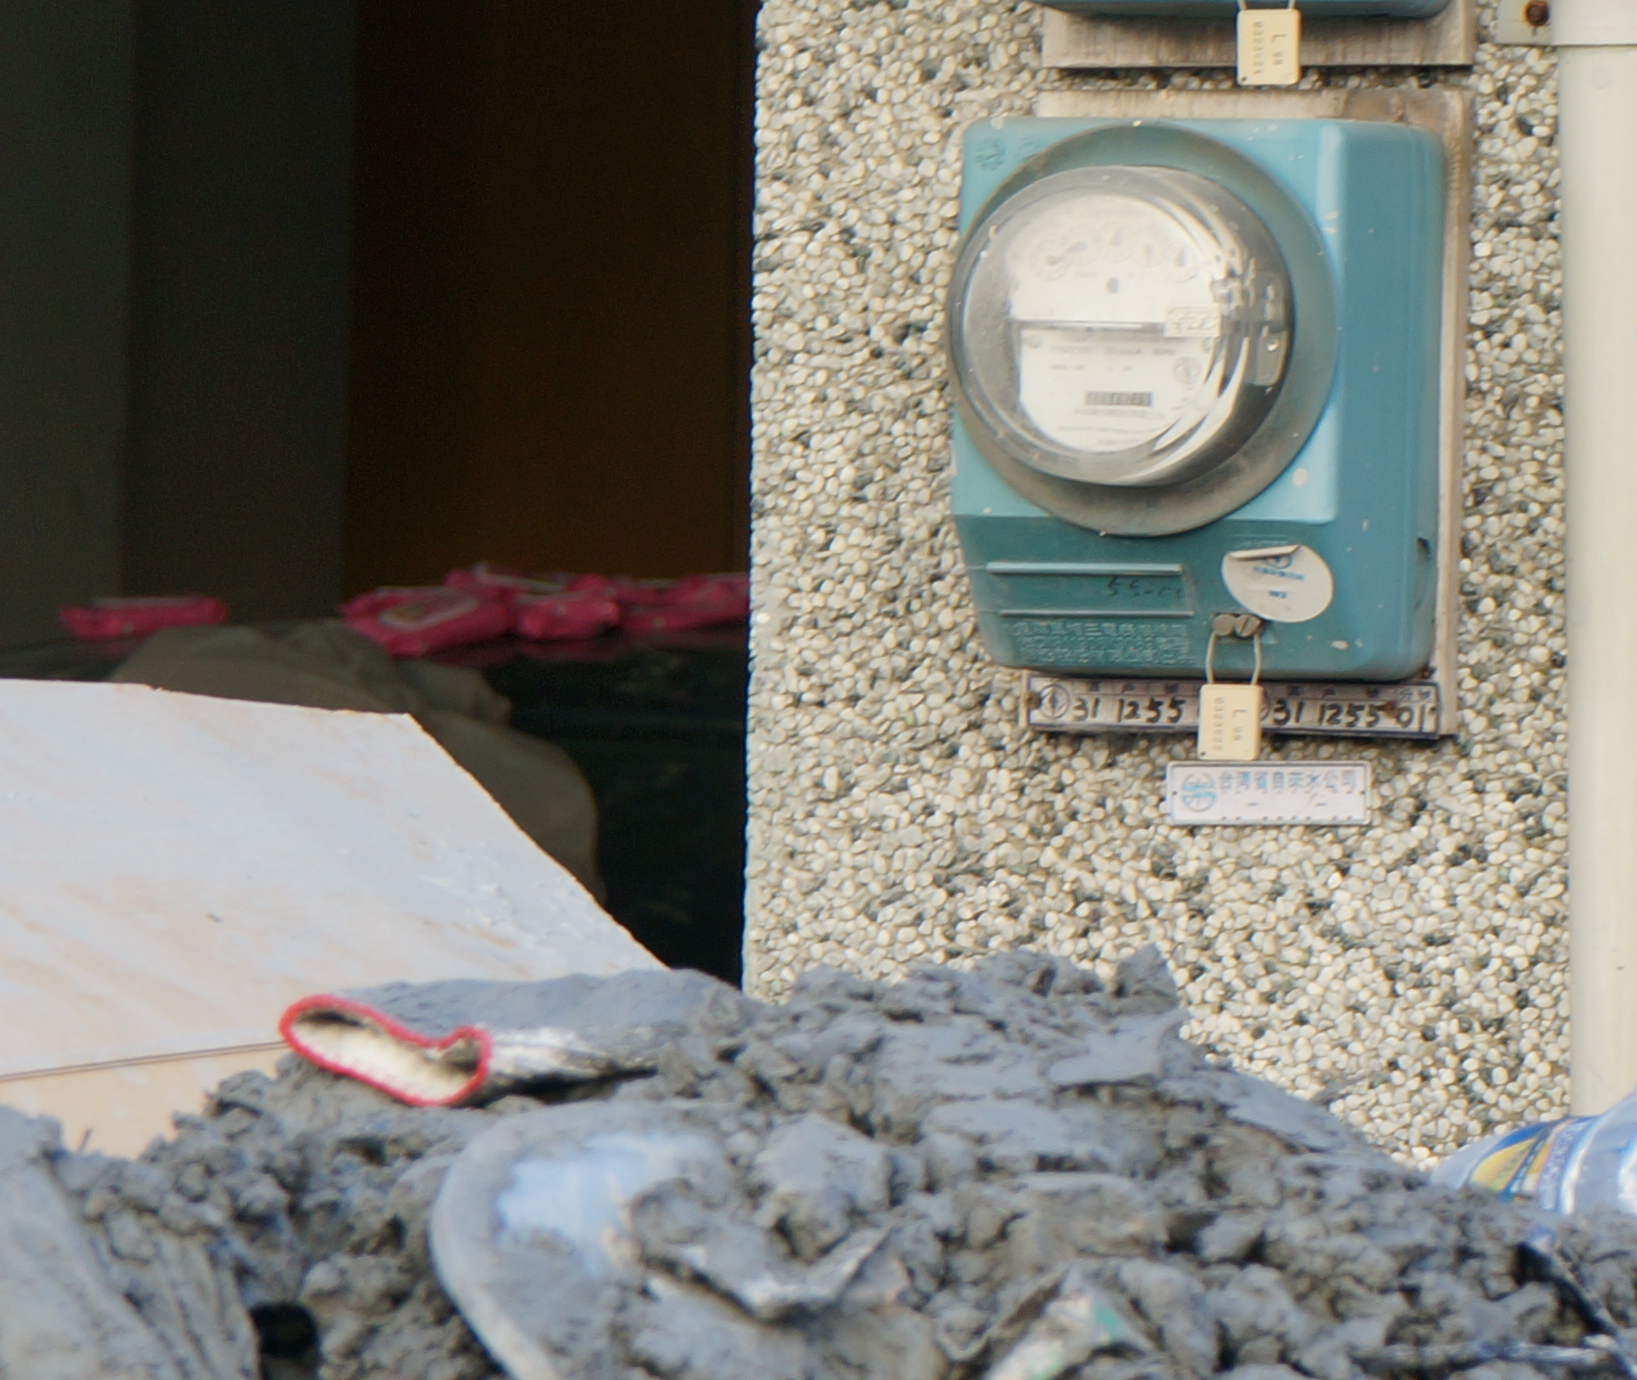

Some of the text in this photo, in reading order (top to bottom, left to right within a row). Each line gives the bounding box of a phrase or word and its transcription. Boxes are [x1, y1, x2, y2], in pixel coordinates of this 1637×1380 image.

[1072, 695, 1187, 724] 31 1255
[1272, 698, 1305, 727] 31
[1316, 703, 1384, 728] 1255
